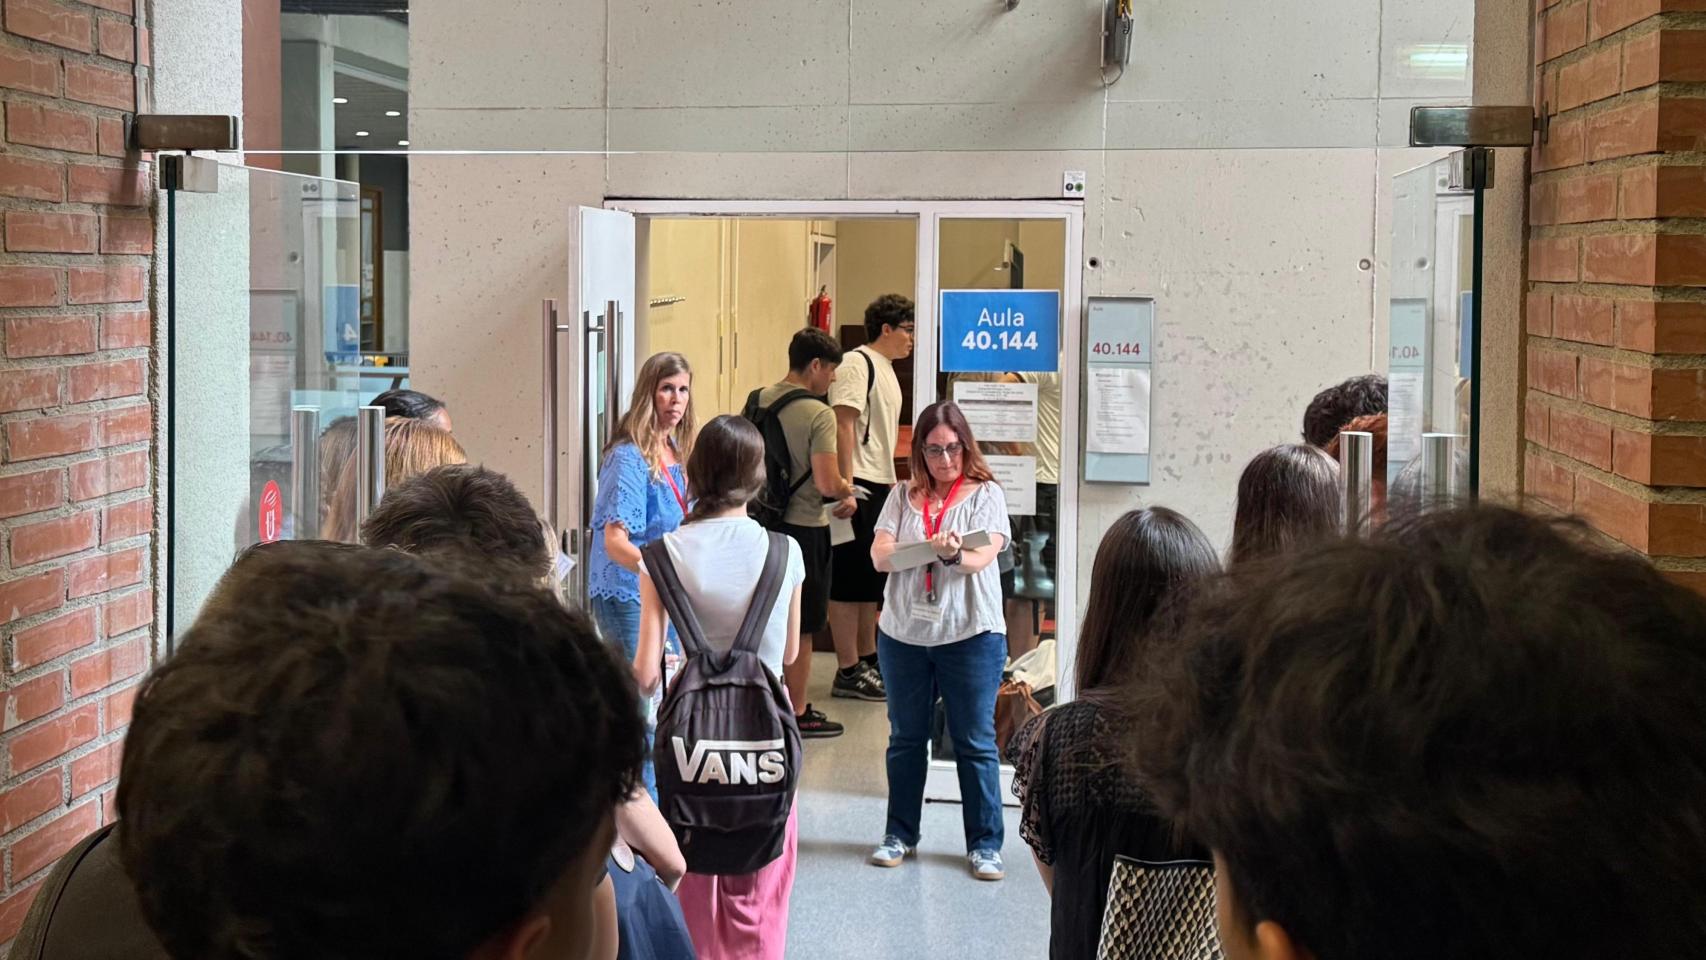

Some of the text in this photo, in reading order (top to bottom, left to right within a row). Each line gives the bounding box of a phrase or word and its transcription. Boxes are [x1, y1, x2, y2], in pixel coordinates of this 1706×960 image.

[977, 307, 1025, 327] Aula
[961, 330, 1039, 350] 40.144
[1092, 342, 1141, 355] 40.144
[671, 736, 785, 785] VANS
